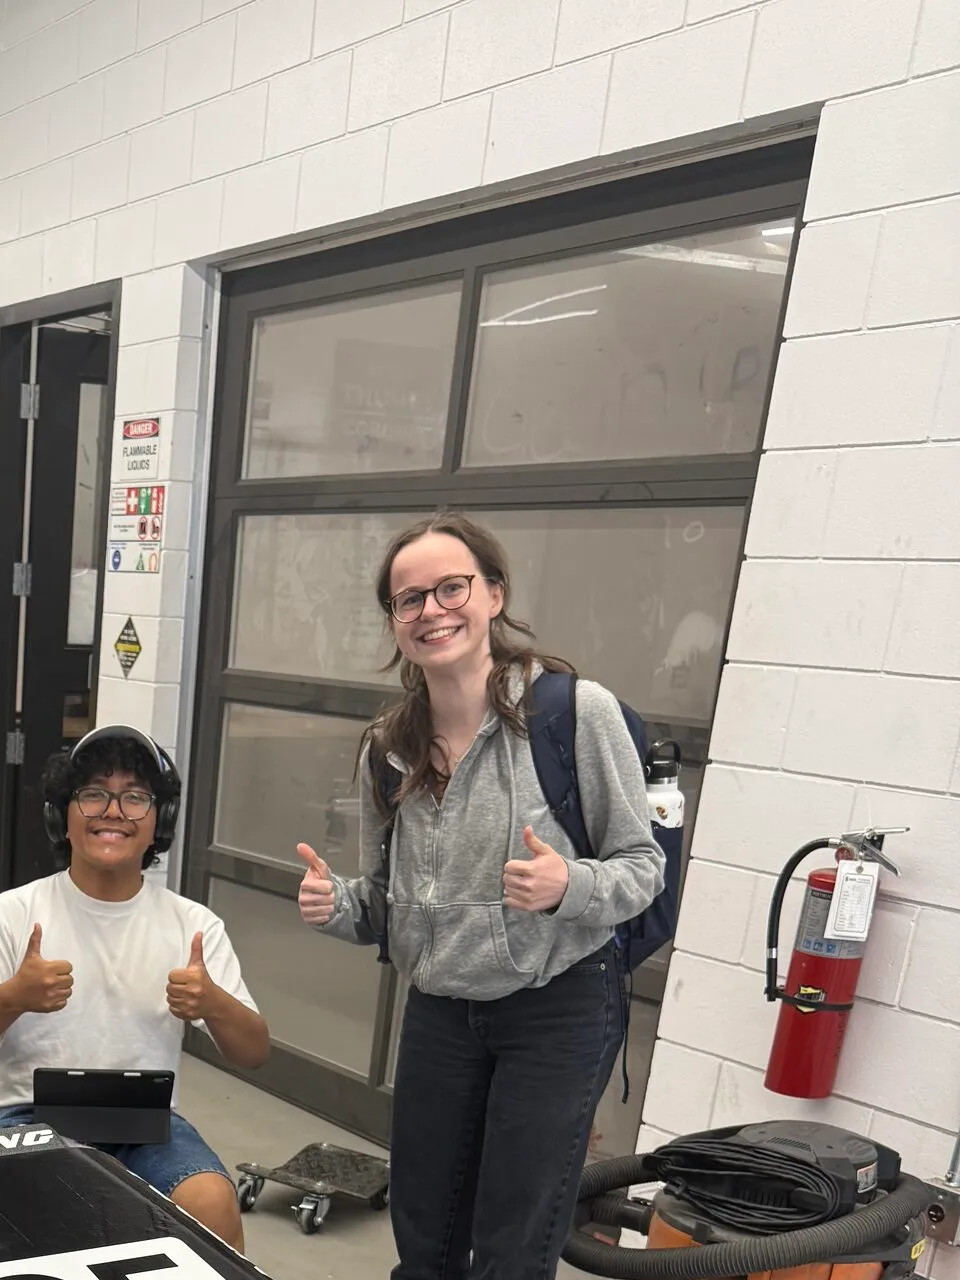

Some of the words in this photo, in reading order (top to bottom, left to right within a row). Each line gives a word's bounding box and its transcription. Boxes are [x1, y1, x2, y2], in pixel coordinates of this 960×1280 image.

[129, 423, 153, 435] DANGER
[122, 444, 157, 457] FLAMMABLE
[127, 459, 150, 471] LIQUIDS
